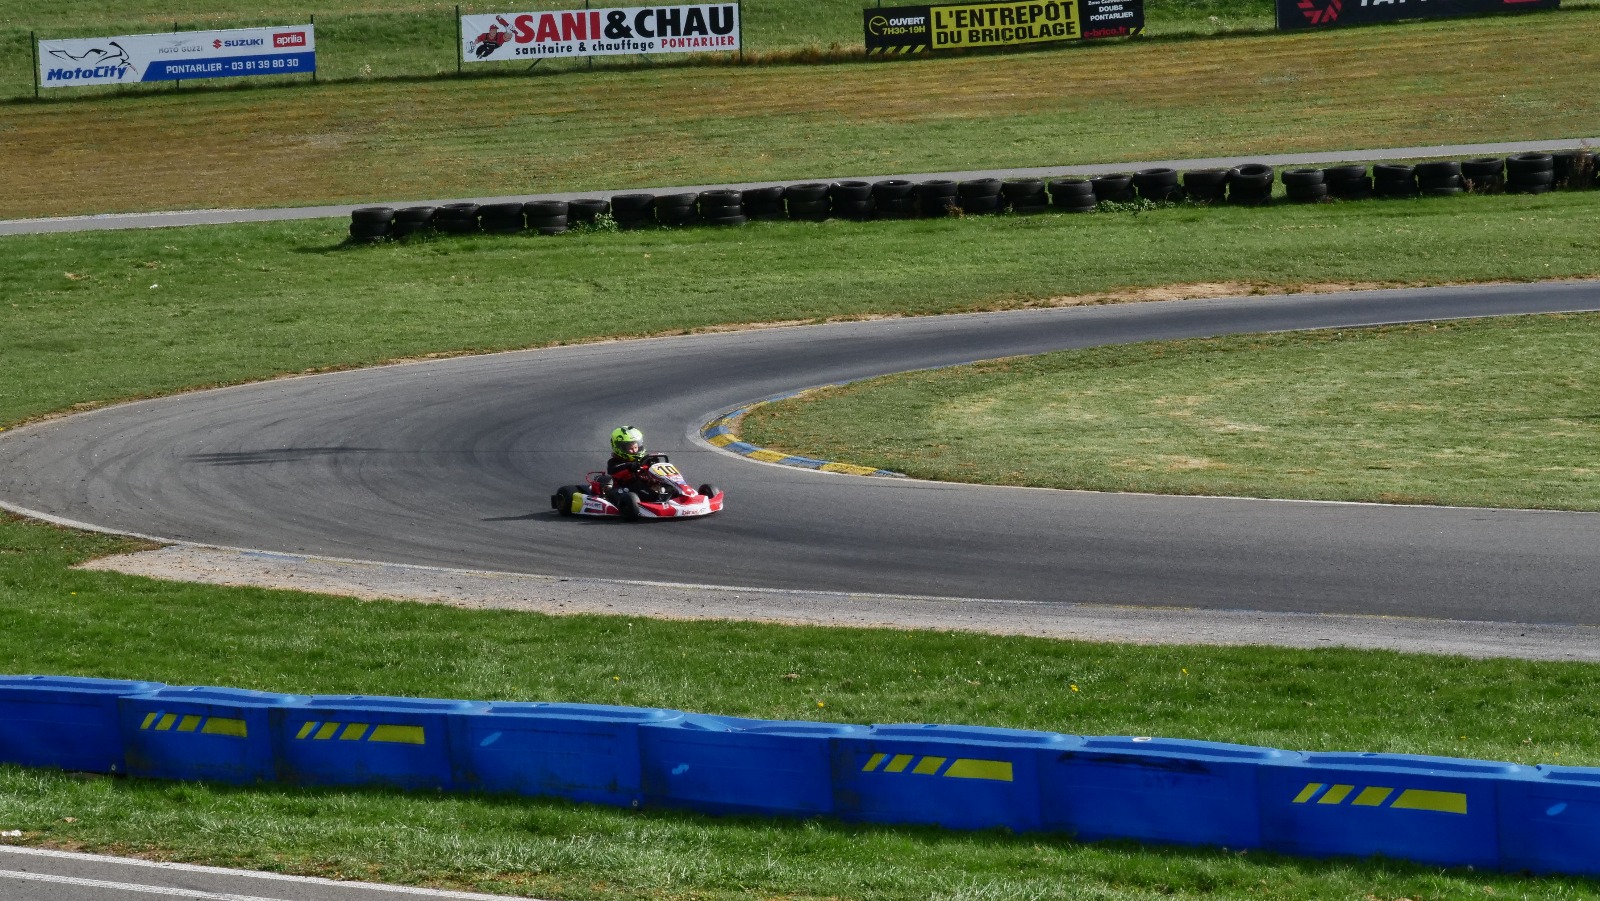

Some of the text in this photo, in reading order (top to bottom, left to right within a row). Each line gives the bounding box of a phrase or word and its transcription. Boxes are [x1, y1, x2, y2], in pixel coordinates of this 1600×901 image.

[1098, 5, 1124, 13] DOUBS
[889, 16, 926, 27] OUVERT
[1089, 11, 1134, 22] PONTARLIER
[514, 6, 734, 44] SANI&CHAU
[882, 25, 926, 36] 7H30-19H
[936, 21, 1077, 45] DU BRICOLAGE
[1083, 26, 1128, 39] e-brico.fr
[224, 38, 264, 48] SUZUKI
[276, 34, 303, 46] aprilia
[158, 46, 178, 54] MOTO
[515, 36, 735, 56] sanitaire & chauffage PONTARLIER
[166, 62, 222, 75] PONTARLIER
[231, 61, 244, 71] 03
[246, 60, 256, 70] 81
[258, 59, 270, 69] 39
[272, 58, 285, 68] 80
[286, 58, 299, 67] 30
[47, 65, 127, 81] MotoCity
[657, 465, 679, 476] 10
